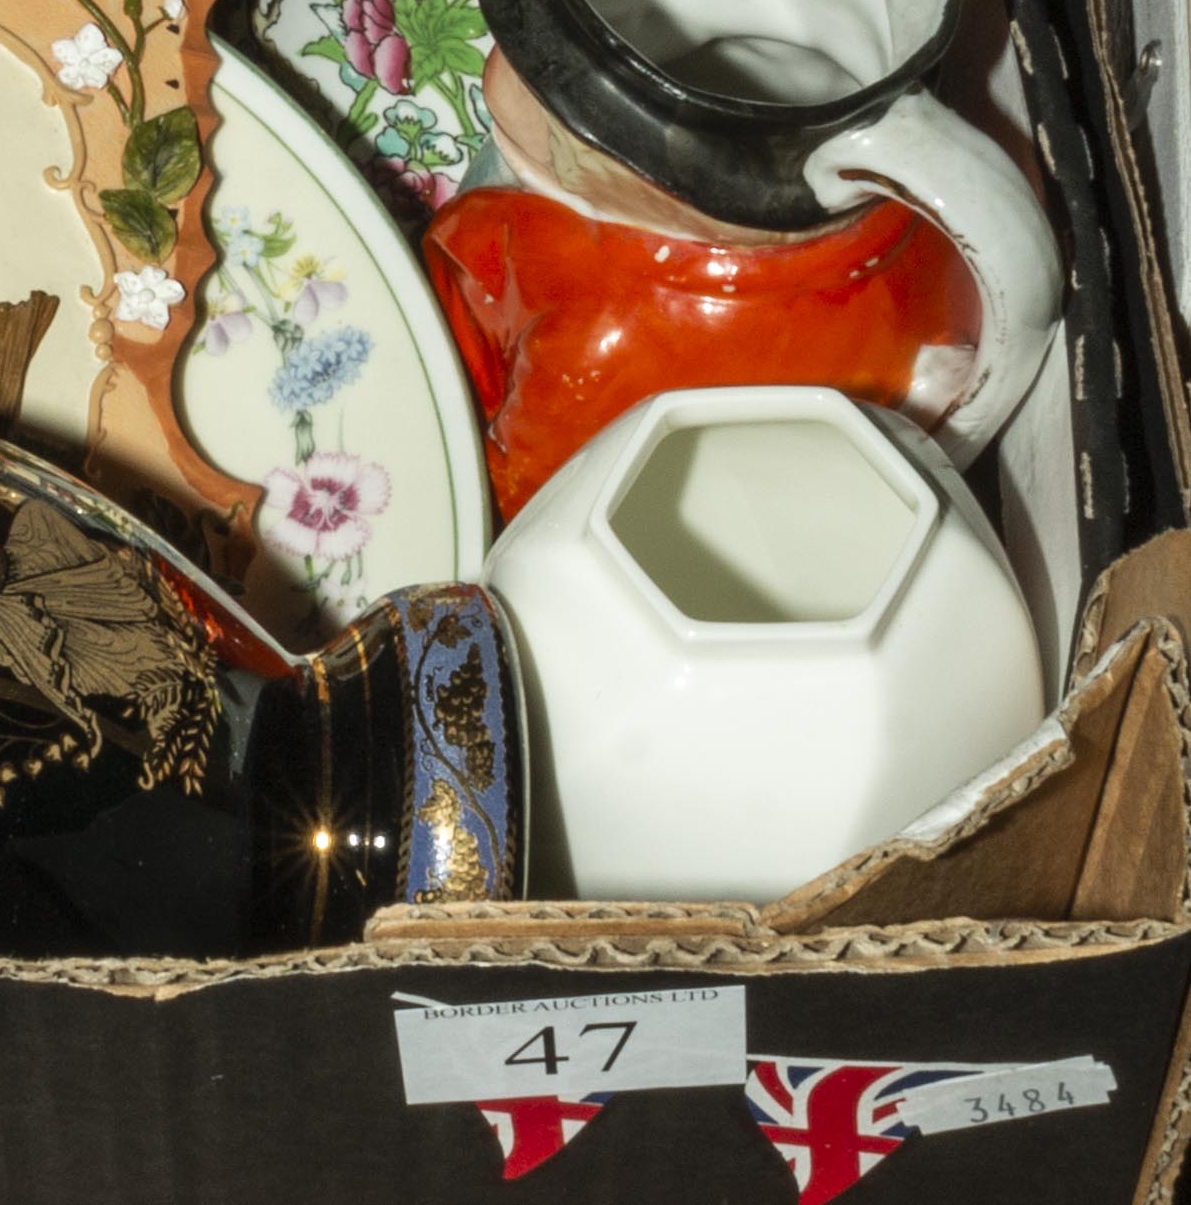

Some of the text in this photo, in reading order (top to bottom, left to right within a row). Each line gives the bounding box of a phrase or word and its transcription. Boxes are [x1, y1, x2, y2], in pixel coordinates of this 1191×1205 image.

[423, 989, 719, 1020] BORDER AUCTIONS LTD
[504, 1021, 638, 1075] 47
[964, 1082, 1075, 1123] 3484
